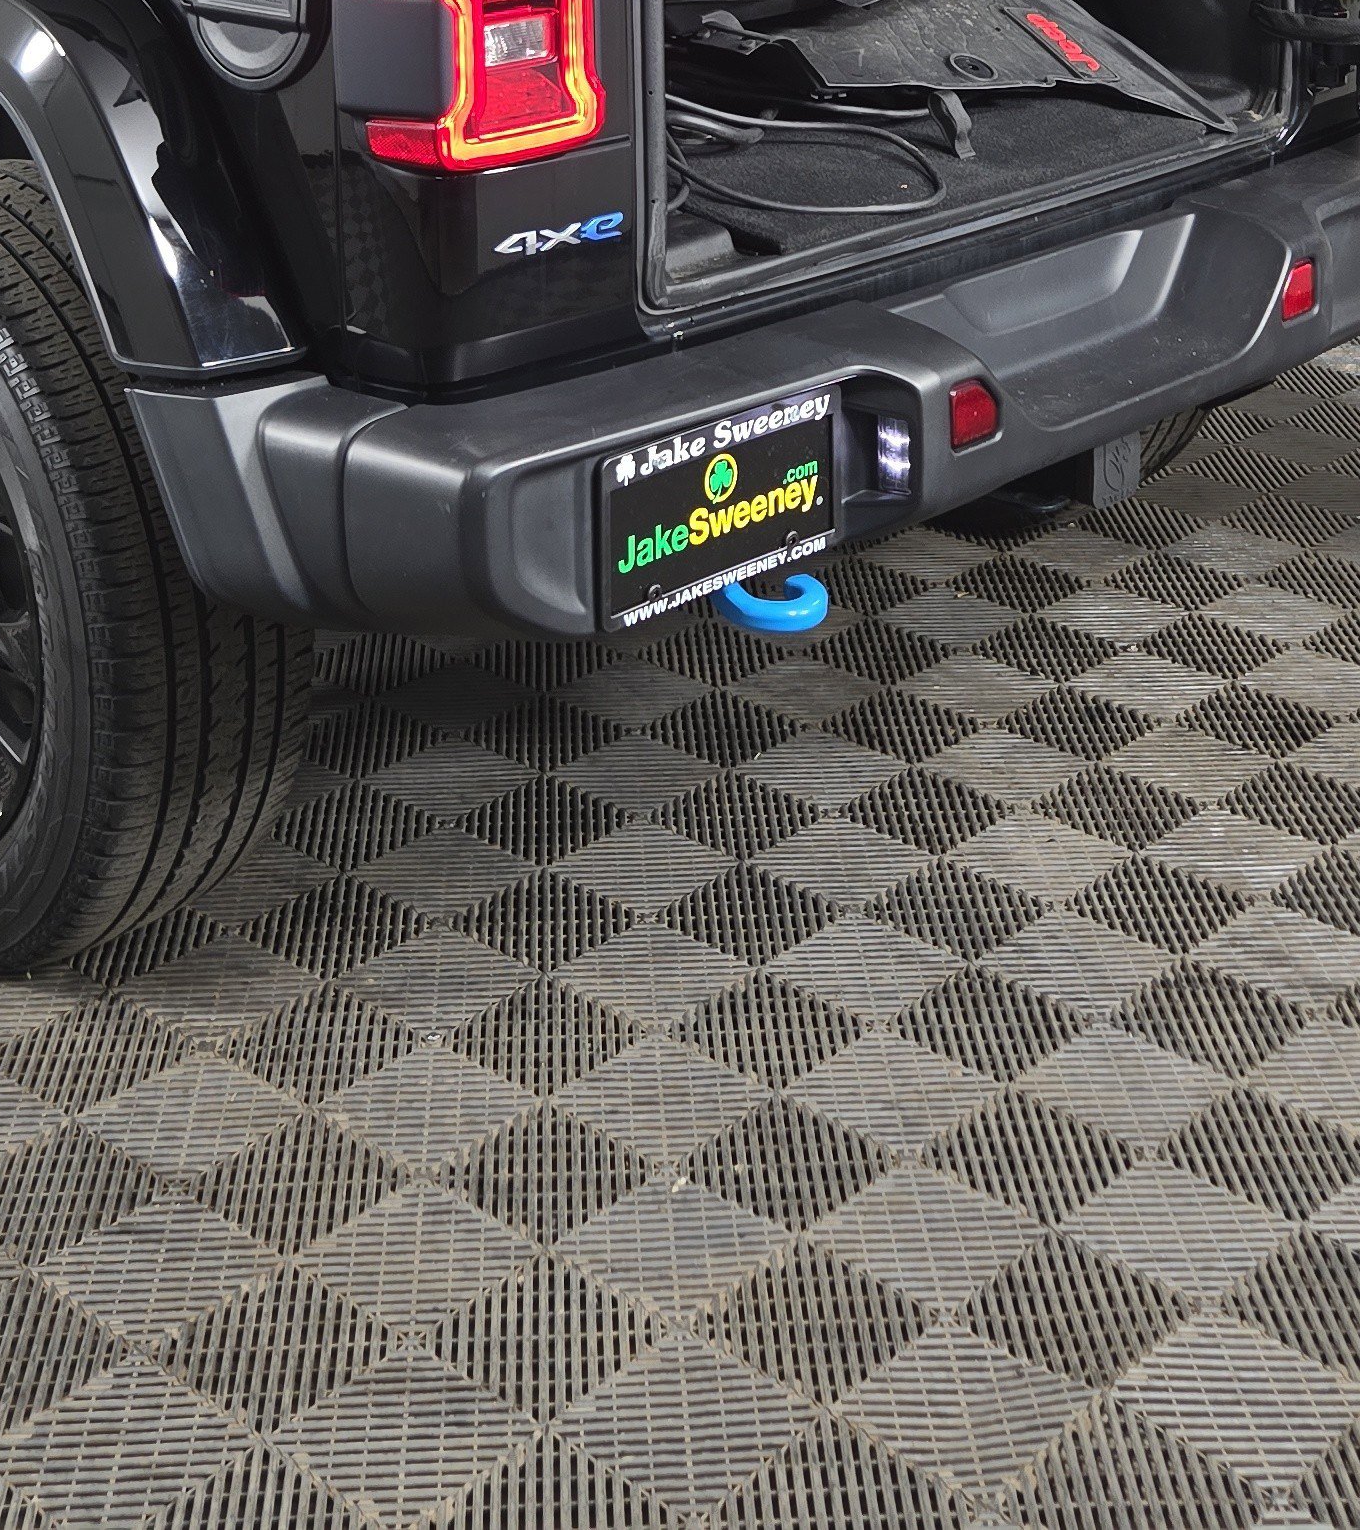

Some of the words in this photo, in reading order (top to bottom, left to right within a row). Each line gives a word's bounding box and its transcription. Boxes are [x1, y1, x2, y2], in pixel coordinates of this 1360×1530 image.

[640, 434, 706, 476] Jake
[713, 393, 830, 449] Sweeney
[782, 460, 818, 485] .com
[623, 536, 826, 627] WWW.JAKESWEENEY.COM
